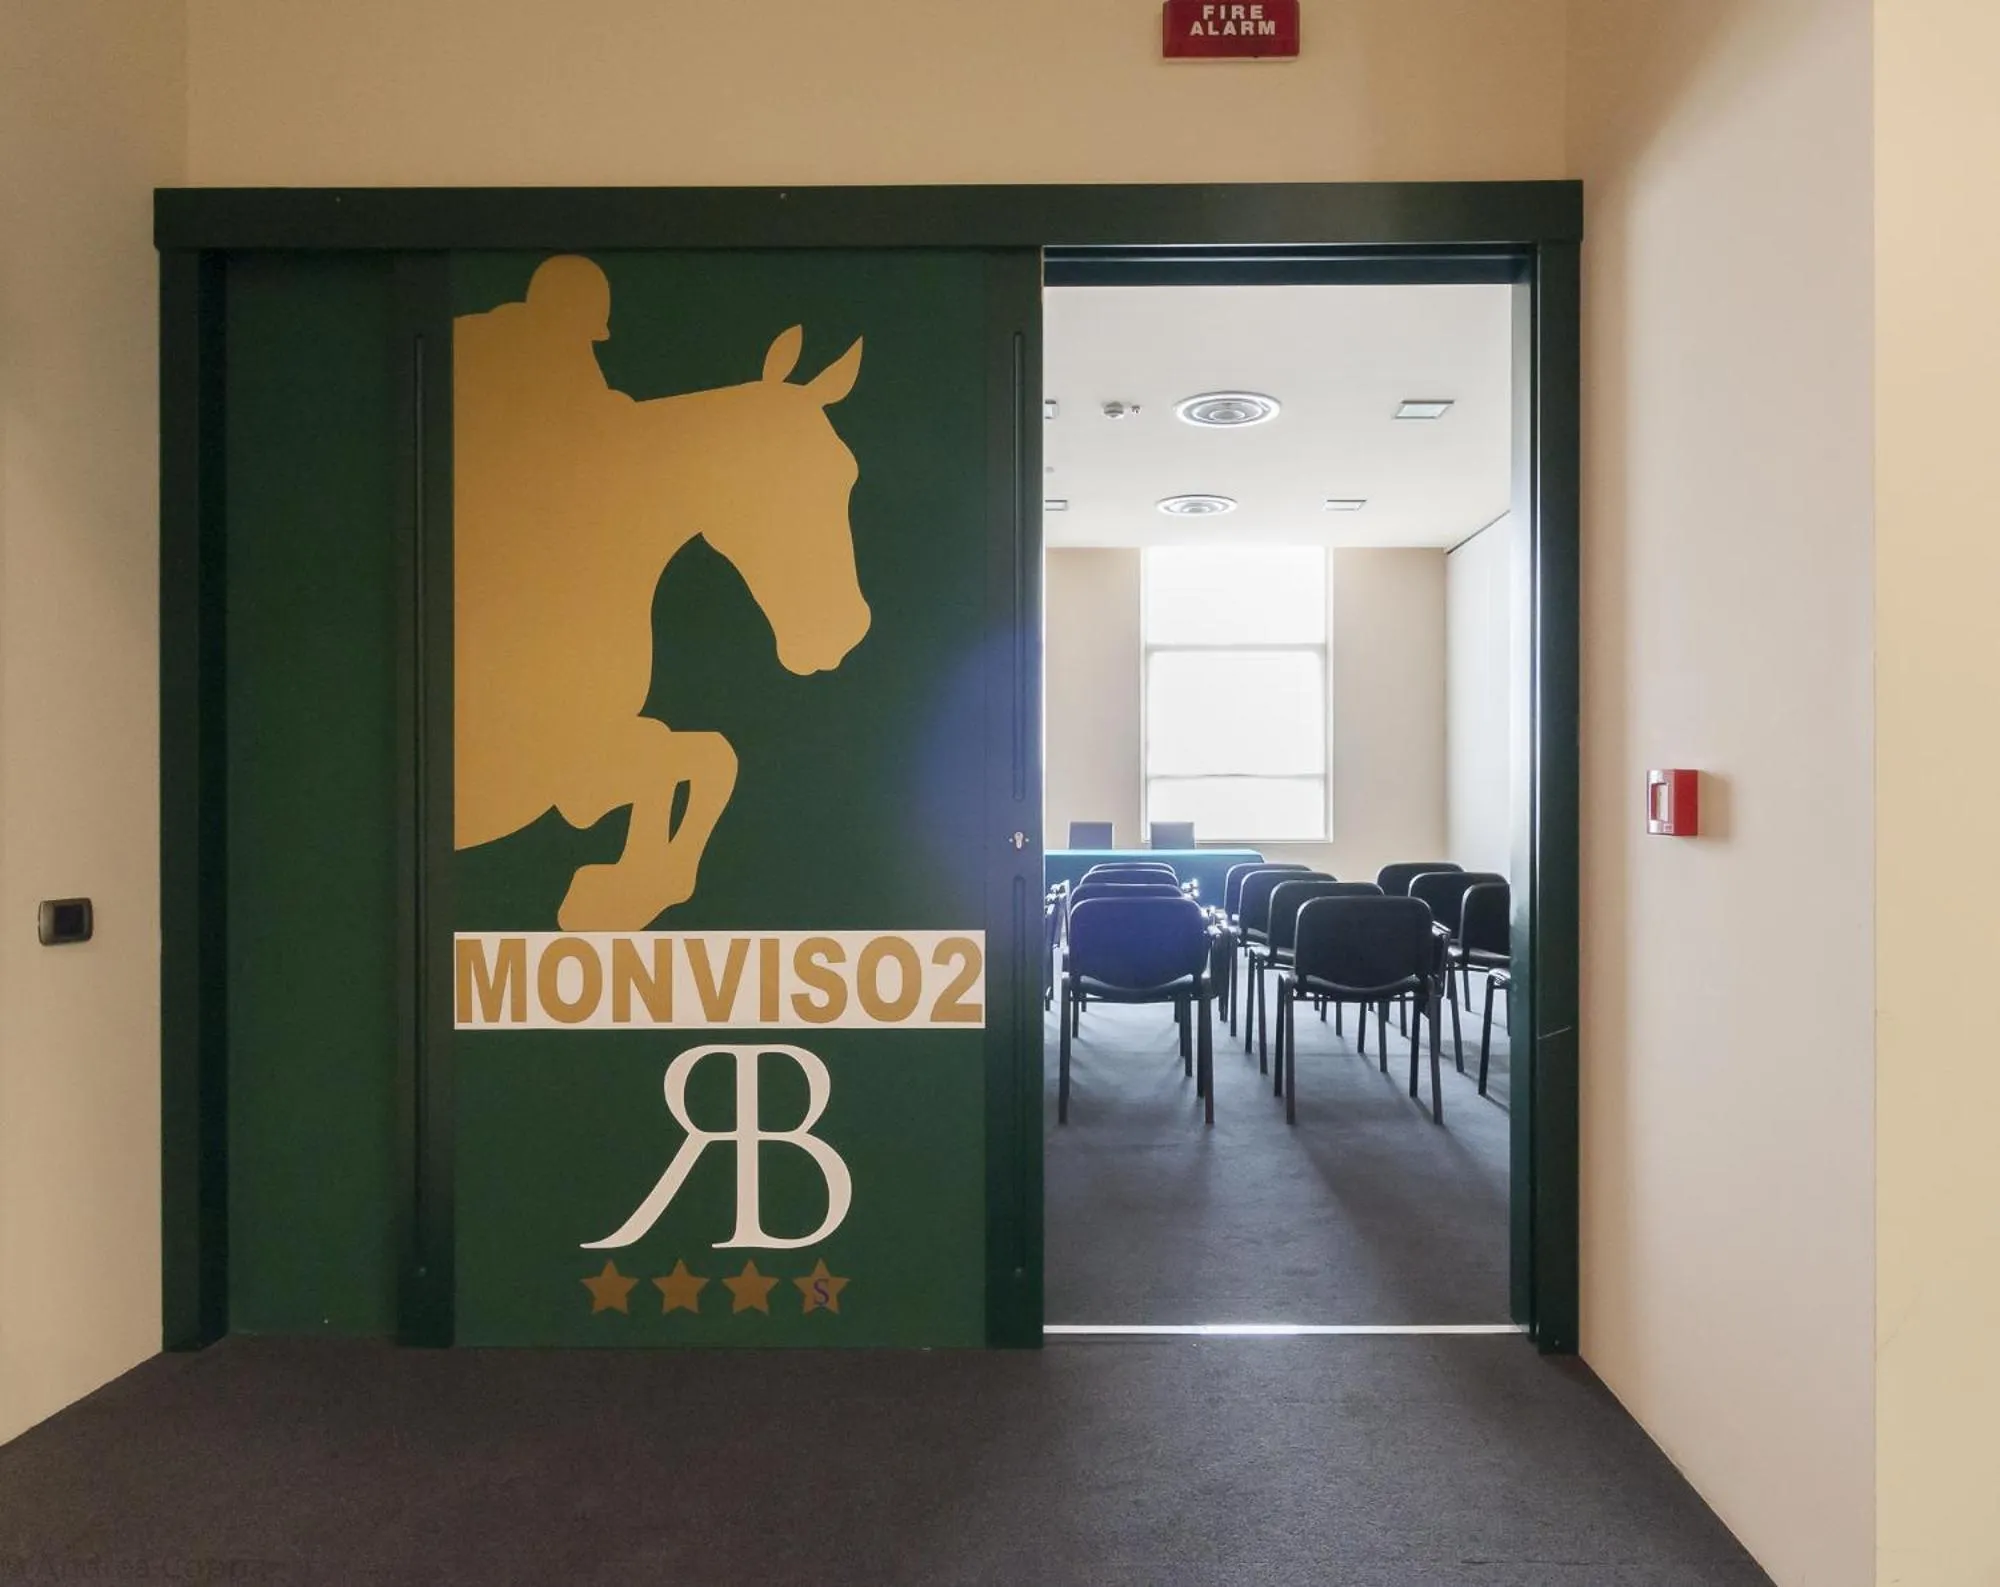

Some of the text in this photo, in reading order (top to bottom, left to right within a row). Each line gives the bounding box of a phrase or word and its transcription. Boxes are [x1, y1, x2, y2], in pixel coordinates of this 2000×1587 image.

[1203, 5, 1264, 20] FIRE
[1190, 20, 1276, 36] ALARM
[455, 936, 983, 1025] MONVISO2
